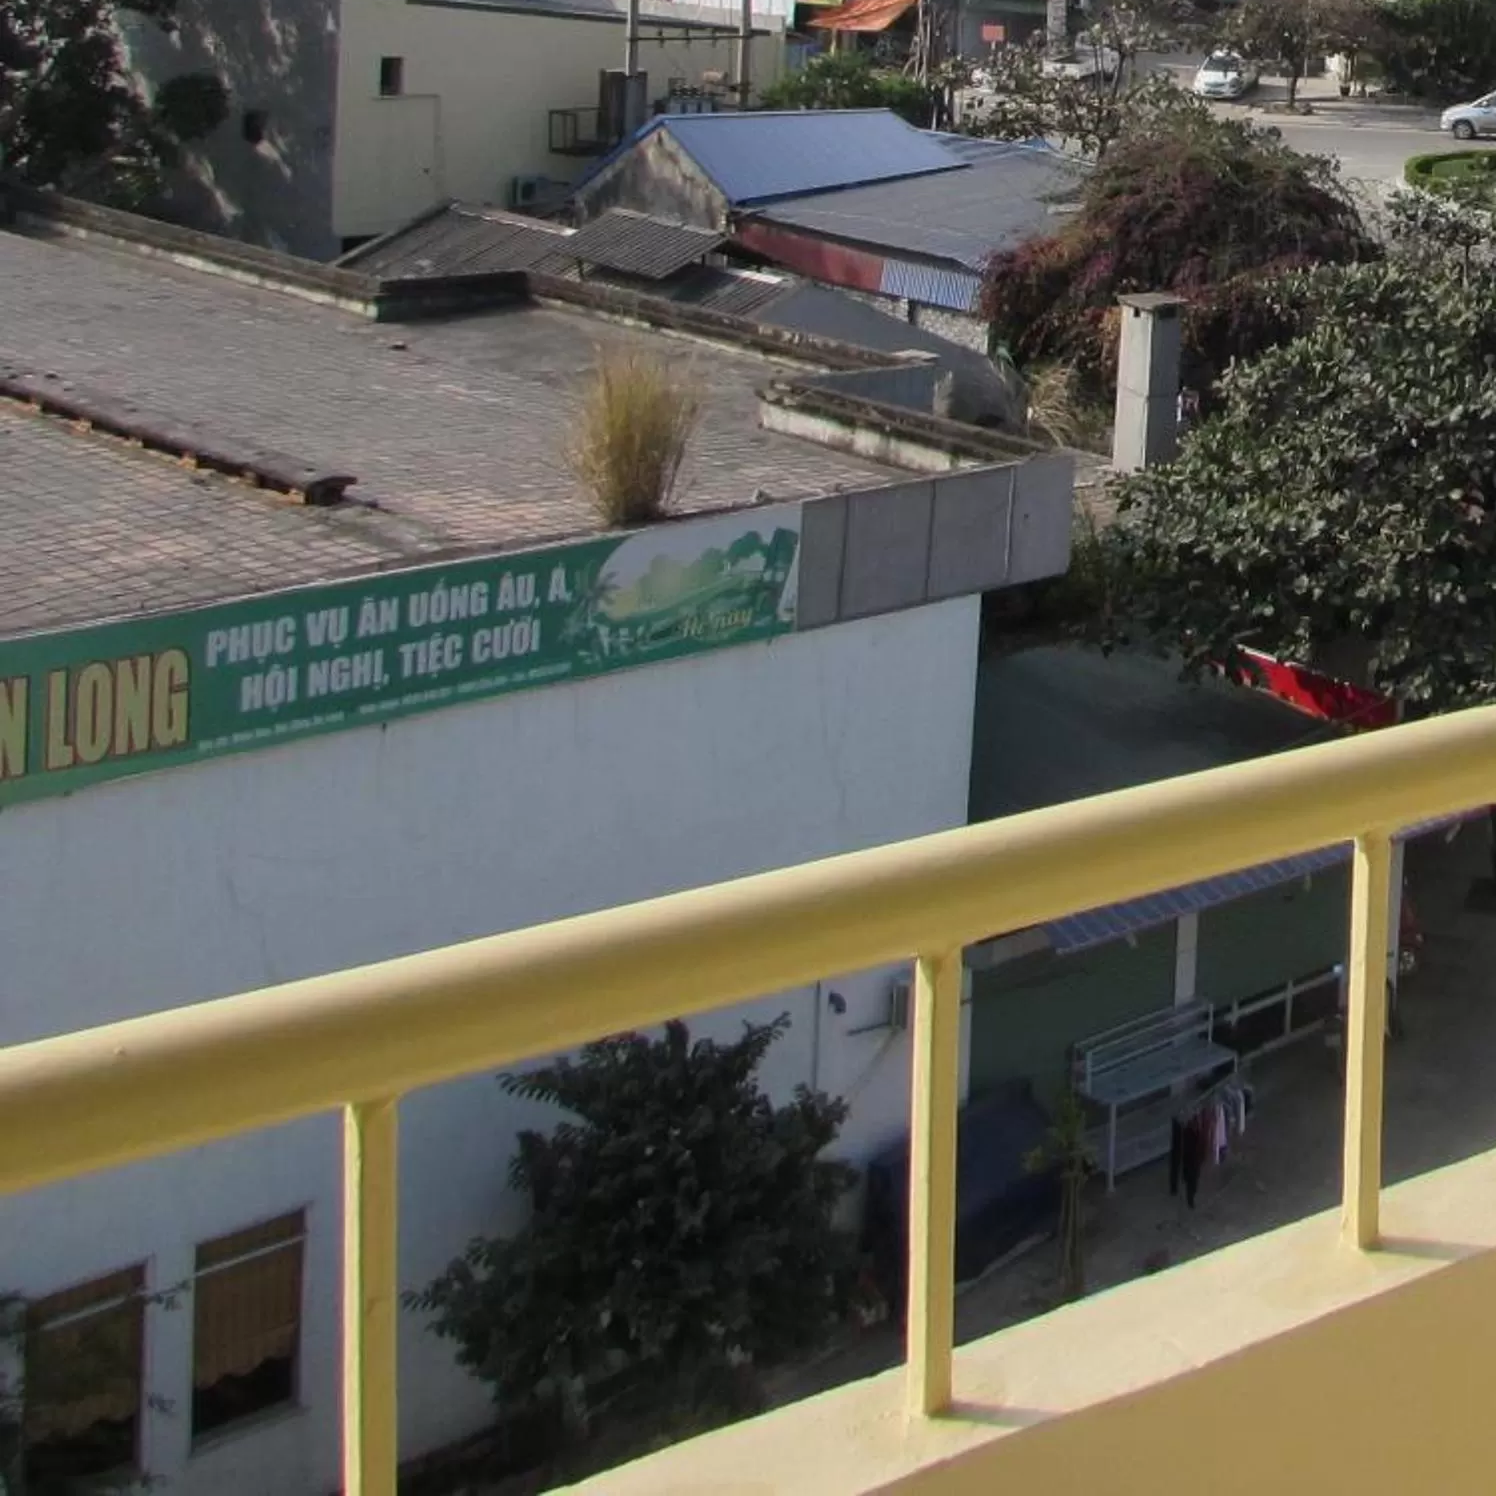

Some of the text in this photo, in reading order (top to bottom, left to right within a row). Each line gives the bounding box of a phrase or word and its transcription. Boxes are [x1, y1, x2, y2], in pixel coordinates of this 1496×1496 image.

[206, 615, 296, 668] PHỤC
[306, 605, 349, 649] VỤ
[357, 595, 399, 638] ĂN
[408, 576, 489, 628] UỐNG
[47, 647, 190, 770] LONG
[240, 663, 298, 714] HỘI
[307, 648, 390, 698] NGHỊ,
[397, 631, 463, 679] TIỆC
